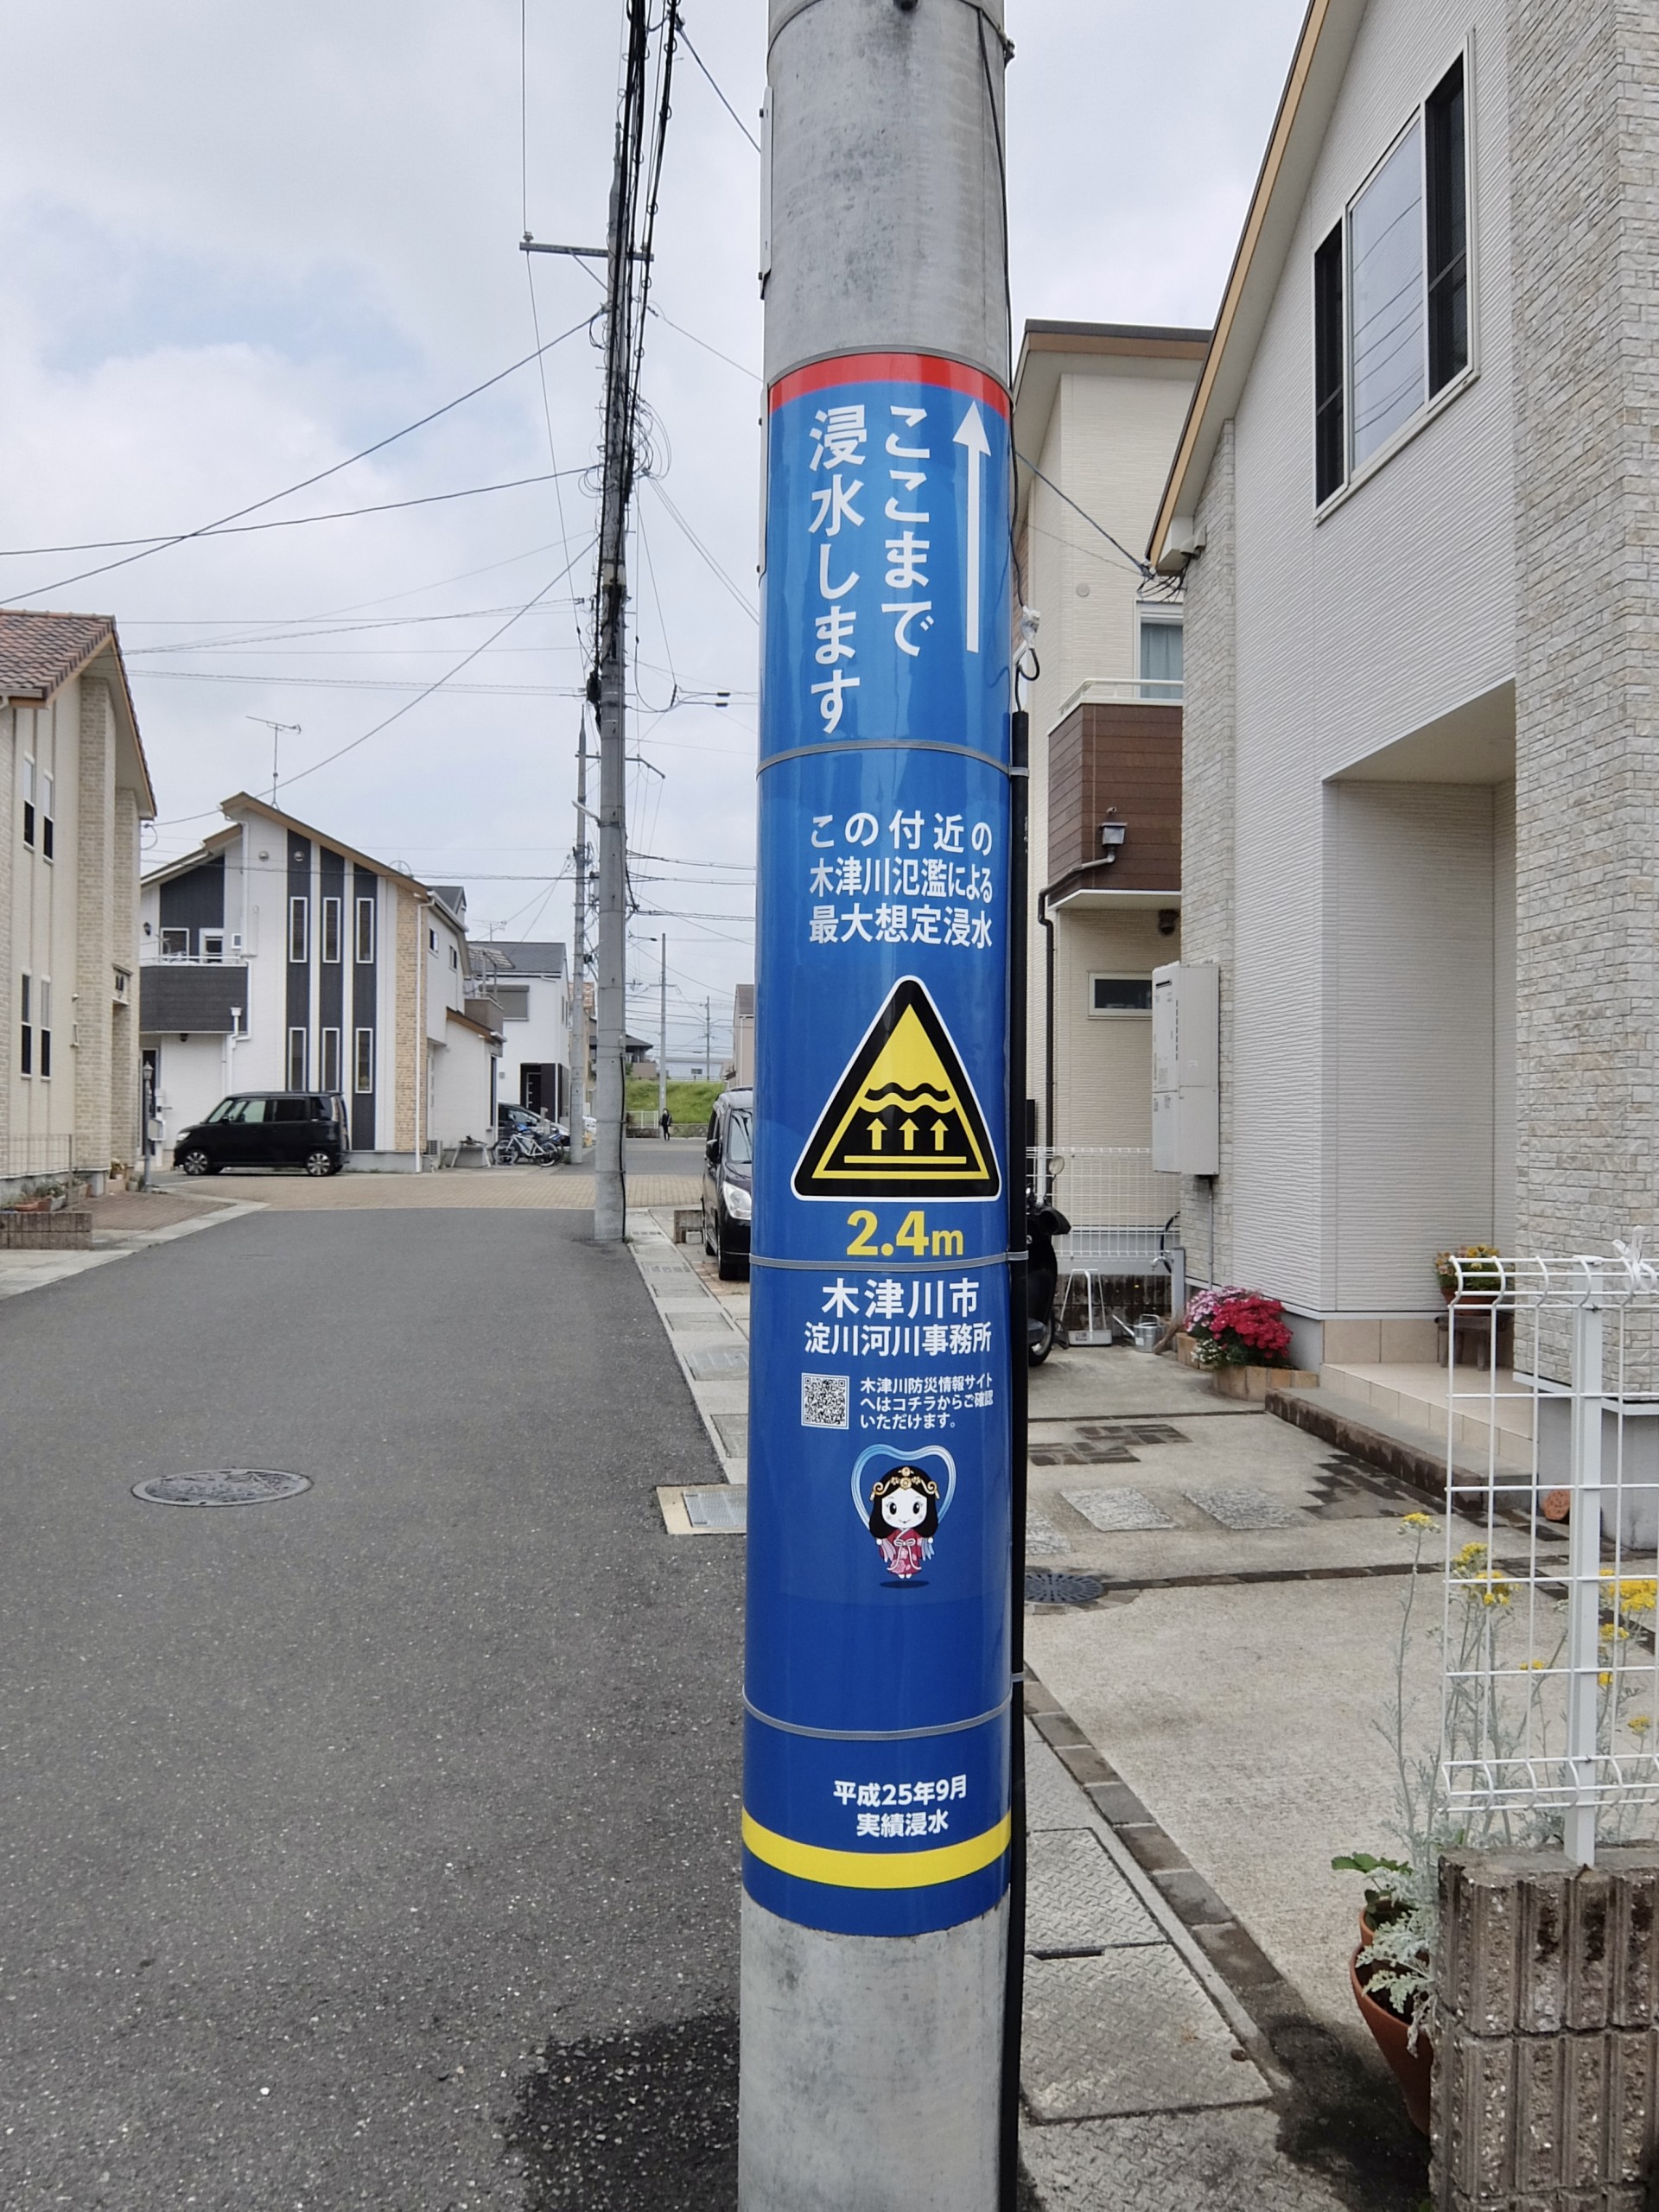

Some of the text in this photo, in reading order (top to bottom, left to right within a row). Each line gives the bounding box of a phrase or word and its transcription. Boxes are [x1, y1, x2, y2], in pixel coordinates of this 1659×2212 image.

[881, 405, 934, 657] ここまで
[808, 404, 867, 734] 浸水します
[810, 809, 993, 856] この付近の
[809, 855, 993, 904] 木津川氾濫による
[809, 902, 993, 950] 最大想定浸水
[846, 1210, 964, 1256] 2.4m
[821, 1277, 980, 1319] 木津川市
[804, 1321, 992, 1357] 淀川河川事務所
[860, 1372, 993, 1395] 木津川防災情報サイト
[860, 1389, 994, 1412] へはコチラからご確認
[860, 1412, 956, 1430] いただけます。
[833, 1774, 967, 1807] 平成25年9月
[856, 1808, 949, 1838] 実績浸水
